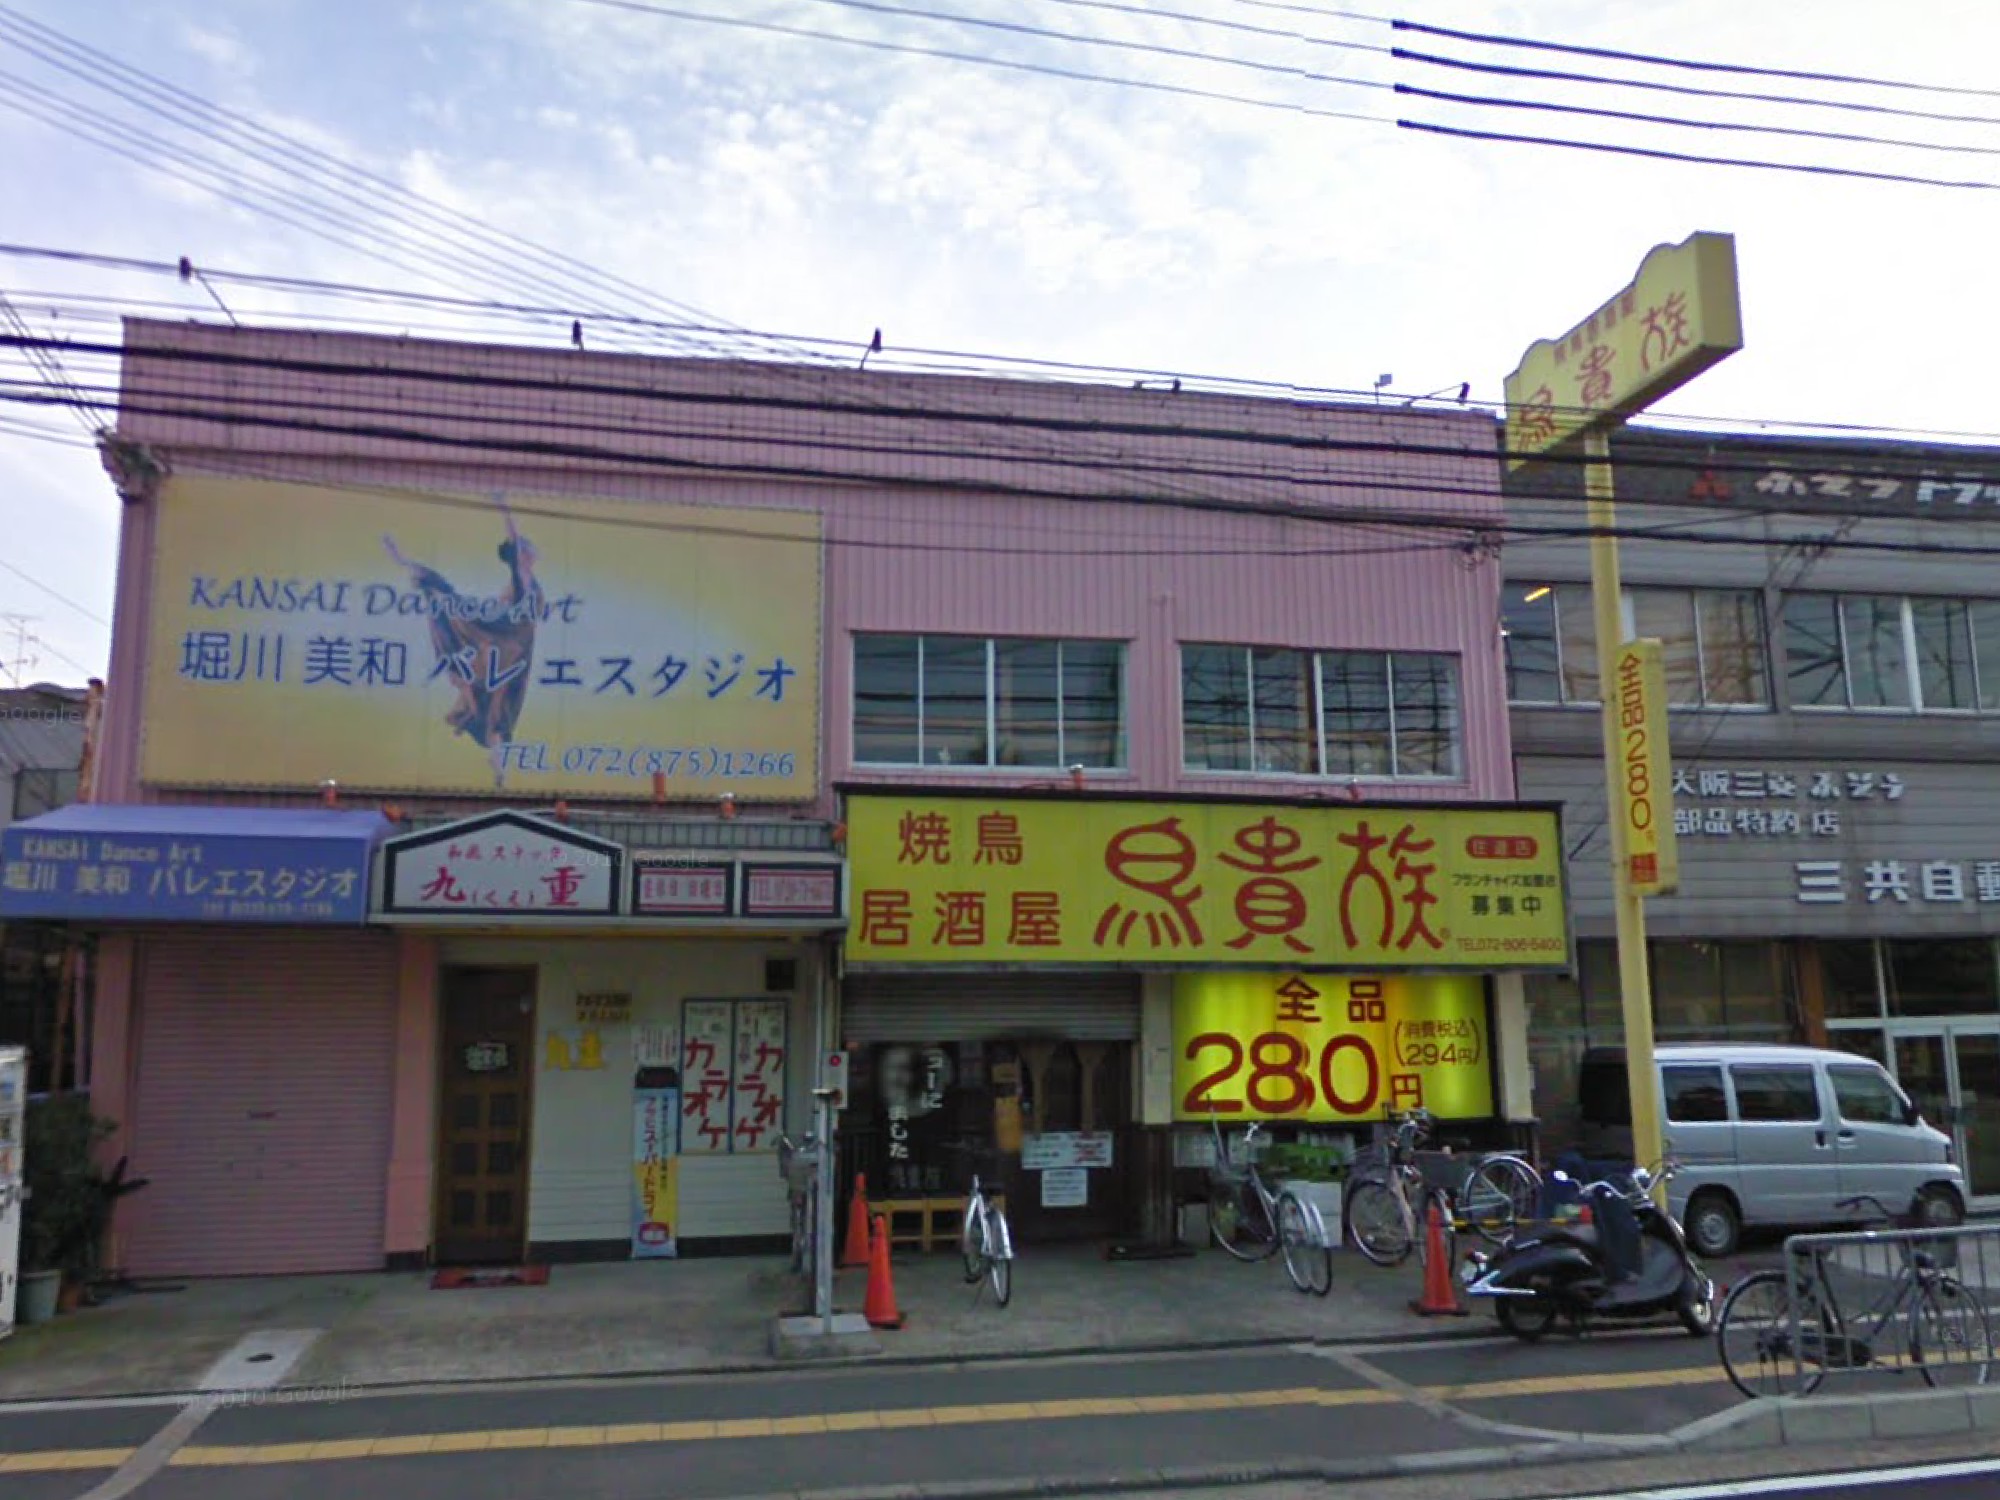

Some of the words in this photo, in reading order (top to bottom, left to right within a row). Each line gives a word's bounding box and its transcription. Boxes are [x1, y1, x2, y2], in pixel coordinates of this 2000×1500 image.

[189, 578, 349, 613] KANSAI
[363, 583, 503, 623] Dance
[179, 632, 283, 685] 堀川
[303, 637, 407, 686] 美和
[431, 645, 795, 702] バレエスタジオ
[498, 744, 551, 772] TEL
[562, 744, 796, 780] 072(875)1266
[899, 810, 1024, 865] 焼鳥
[1673, 808, 1840, 836] 部品特約店
[149, 863, 358, 899] バレエスタジオ
[1094, 816, 1443, 953] 鳥貴族
[859, 889, 1060, 947] 居酒屋
[1277, 976, 1385, 1022] 全品
[683, 1037, 730, 1149] カラオケ
[735, 1041, 784, 1149] カラオケ
